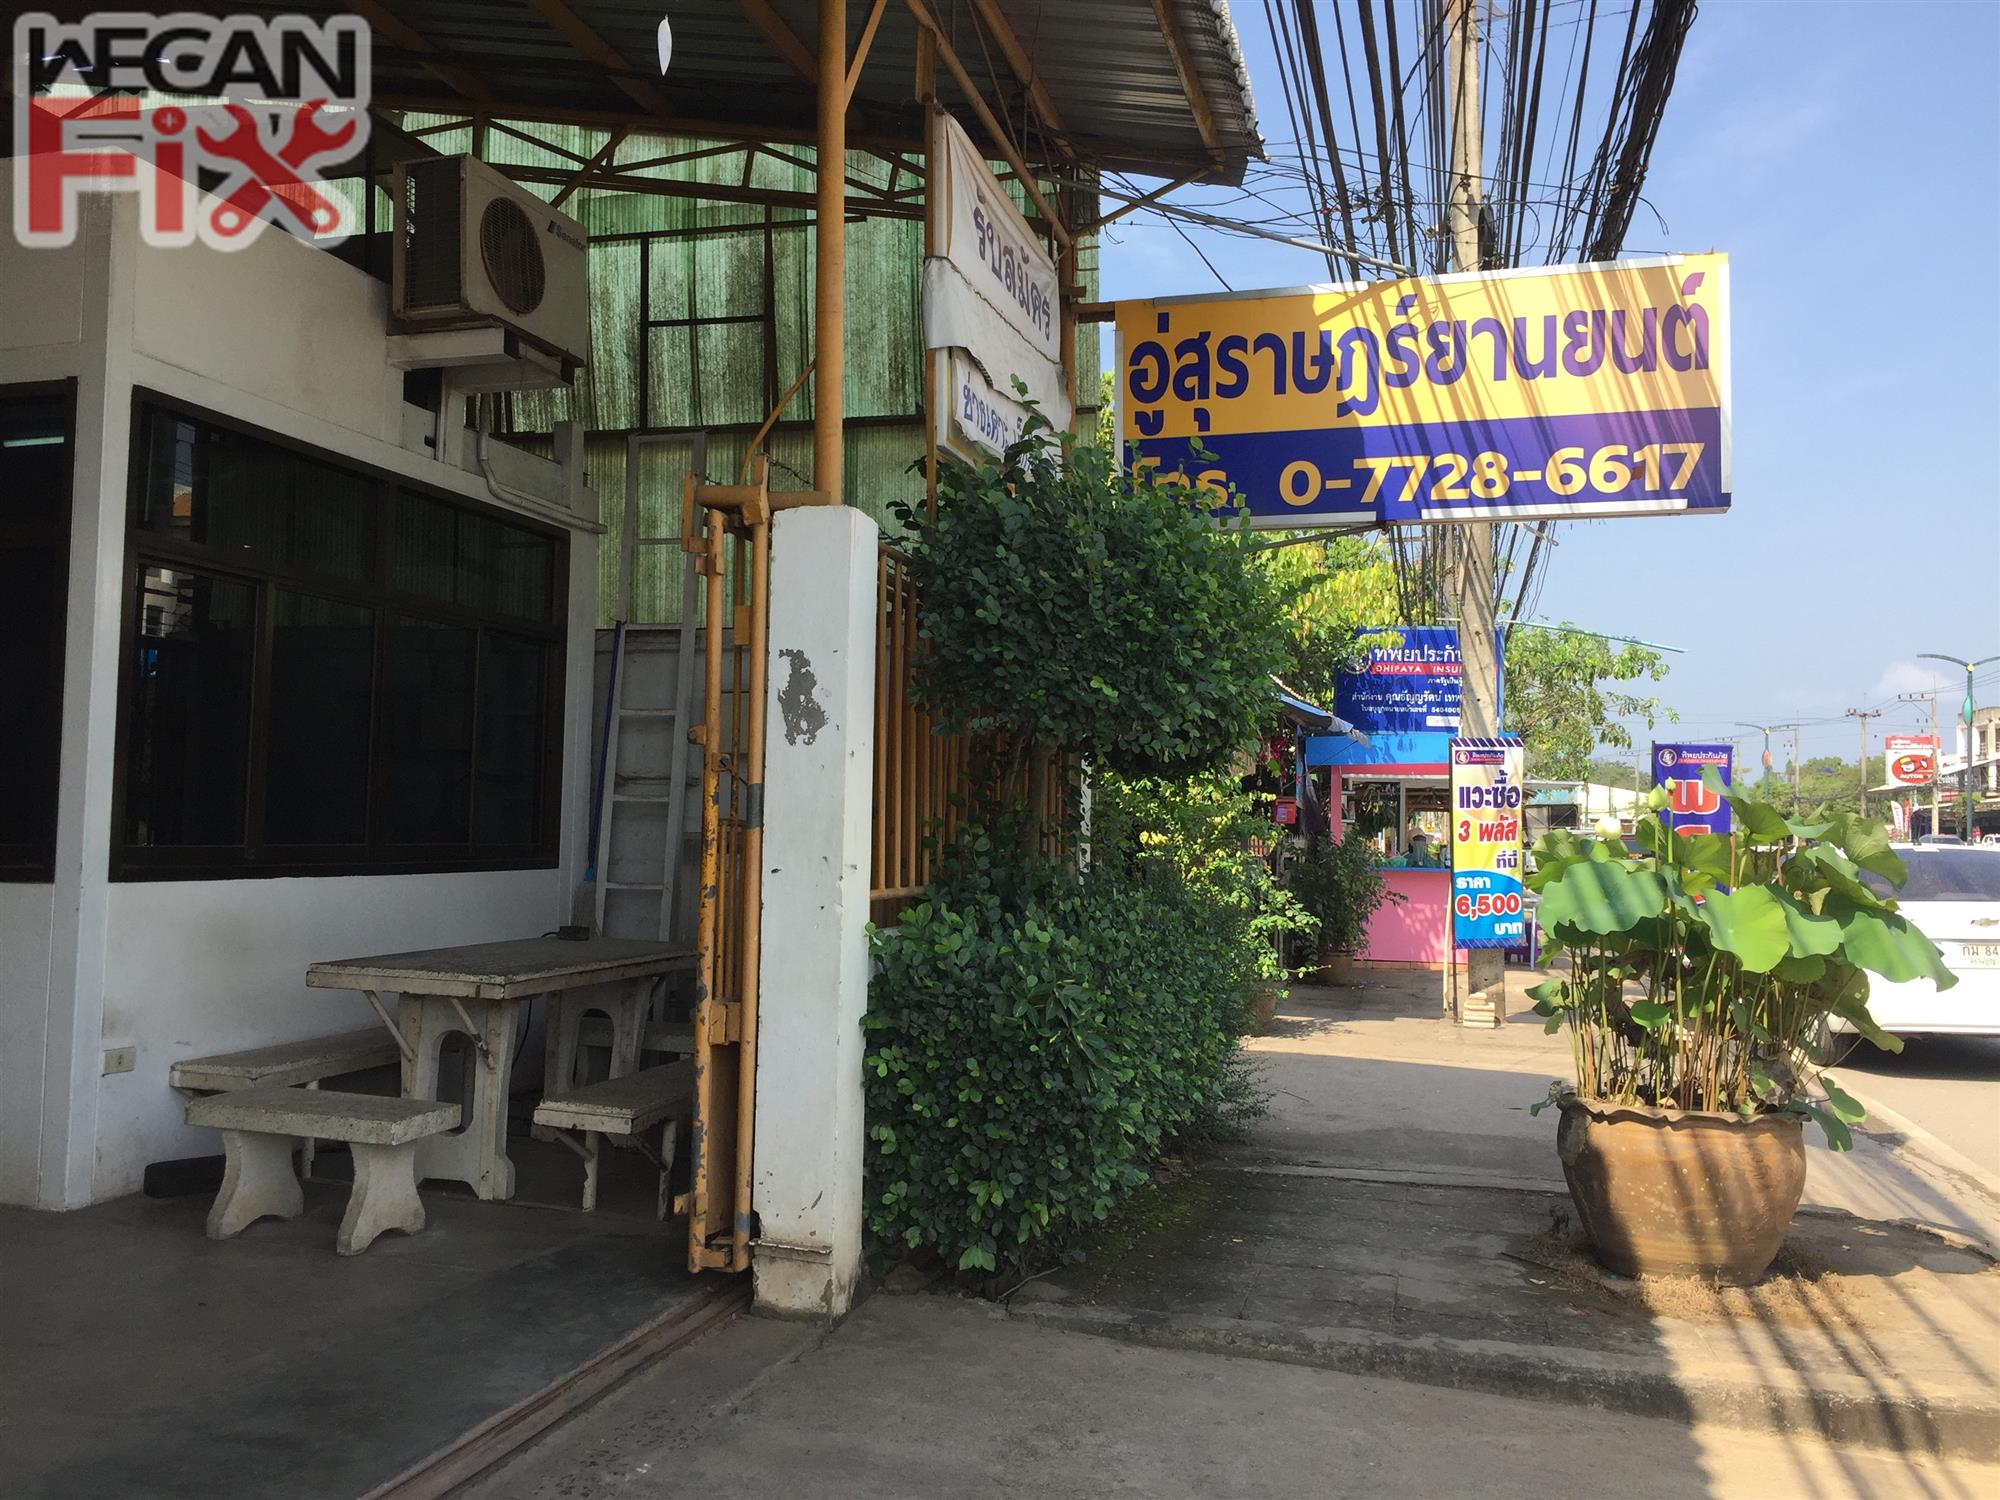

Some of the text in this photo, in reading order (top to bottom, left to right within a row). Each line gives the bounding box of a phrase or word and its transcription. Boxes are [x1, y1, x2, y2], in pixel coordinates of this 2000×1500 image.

[1128, 272, 1710, 437] อู่สุราษฎร์ยานยนต์
[1279, 442, 1705, 507] 0-7728-6617
[1459, 770, 1521, 810] แวะซื้อ
[1458, 815, 1518, 842] 3 พลัส
[1456, 877, 1490, 889] ราคา
[1456, 894, 1520, 920] 6,500
